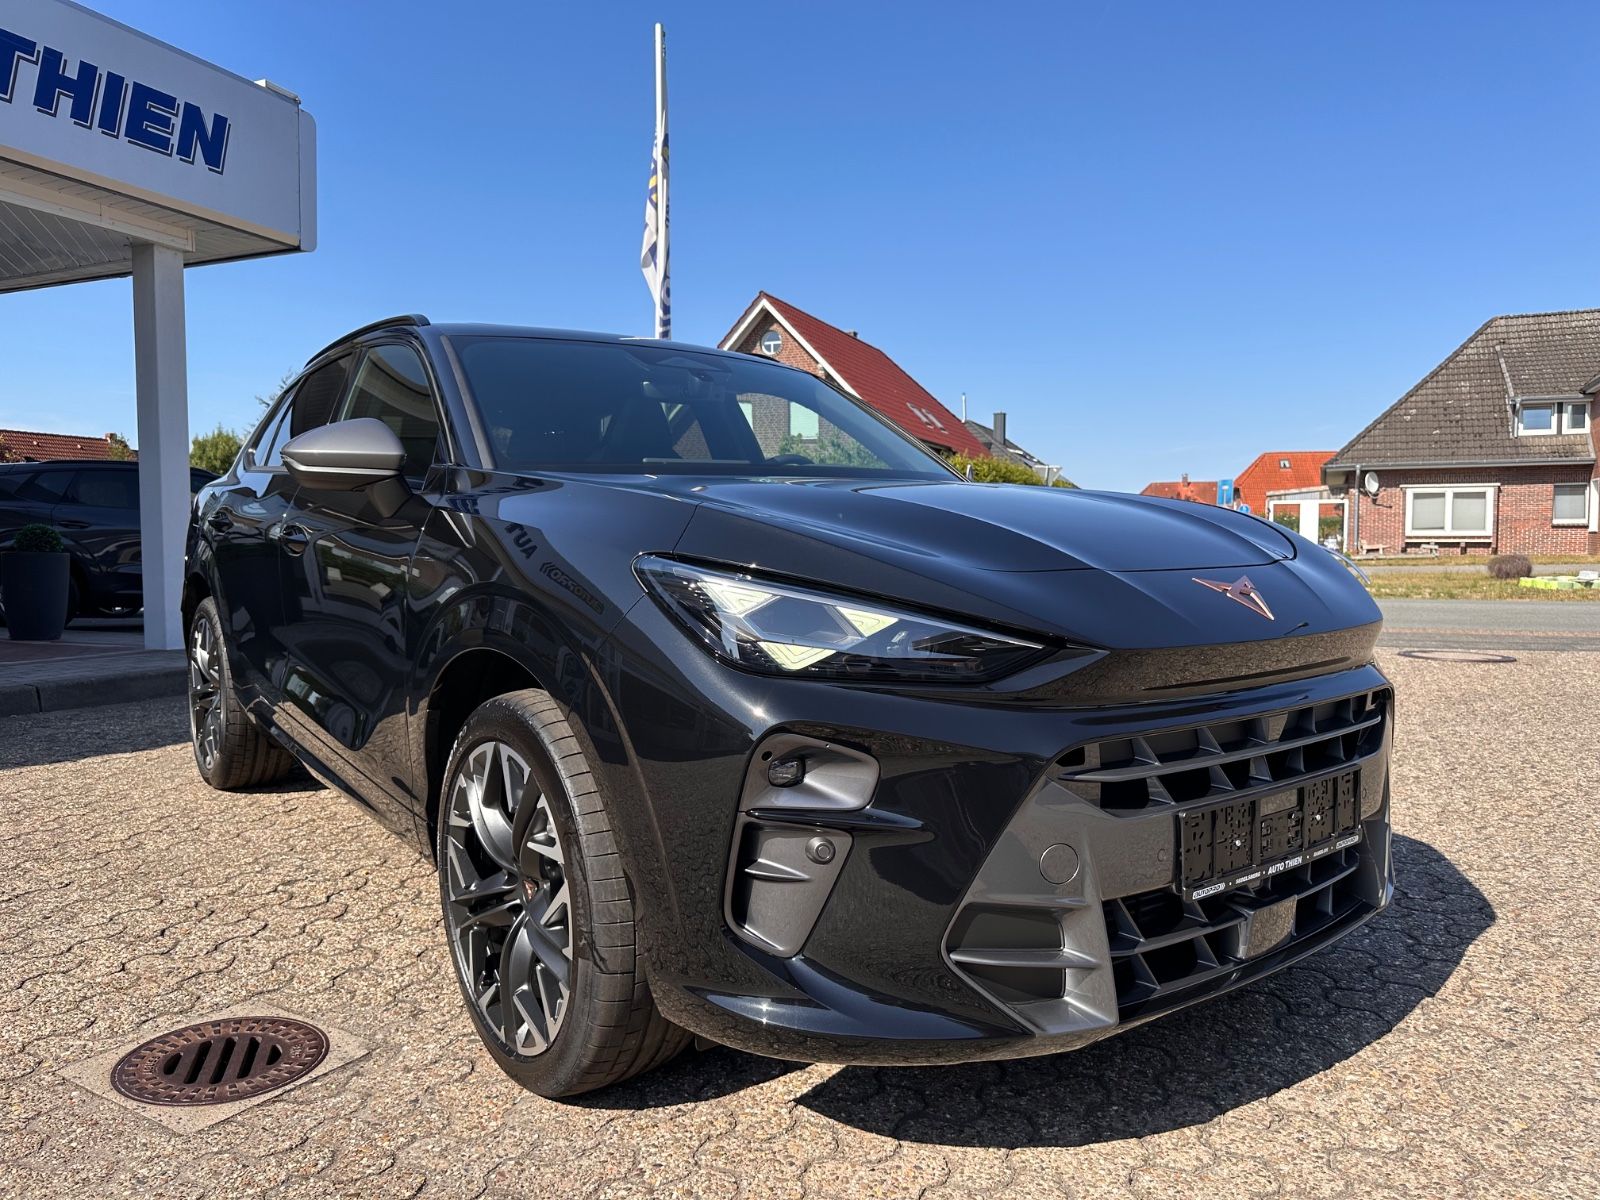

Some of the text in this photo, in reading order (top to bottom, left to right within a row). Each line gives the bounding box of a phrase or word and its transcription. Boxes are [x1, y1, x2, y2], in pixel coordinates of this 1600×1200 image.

[0, 28, 231, 175] THIEN
[1267, 863, 1285, 875] AUTO
[1285, 856, 1303, 868] THIEN
